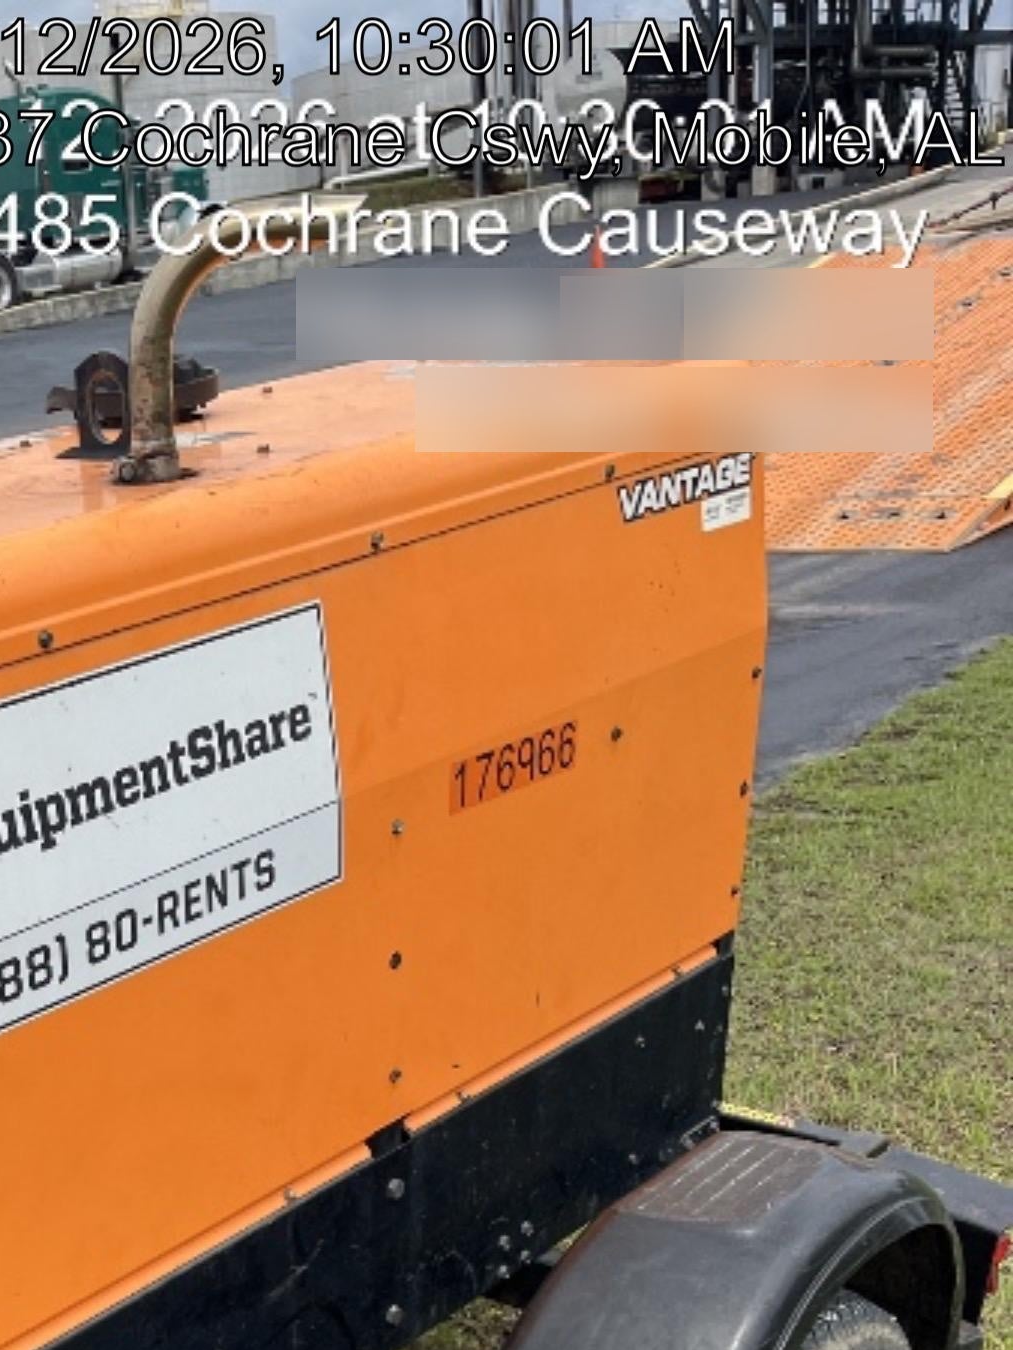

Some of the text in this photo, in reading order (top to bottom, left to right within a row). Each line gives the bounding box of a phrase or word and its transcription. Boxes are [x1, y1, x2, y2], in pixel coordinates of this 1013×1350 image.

[618, 451, 753, 523] VANTAGE
[454, 721, 576, 808] 176966
[87, 848, 277, 965] 80-RENTS
